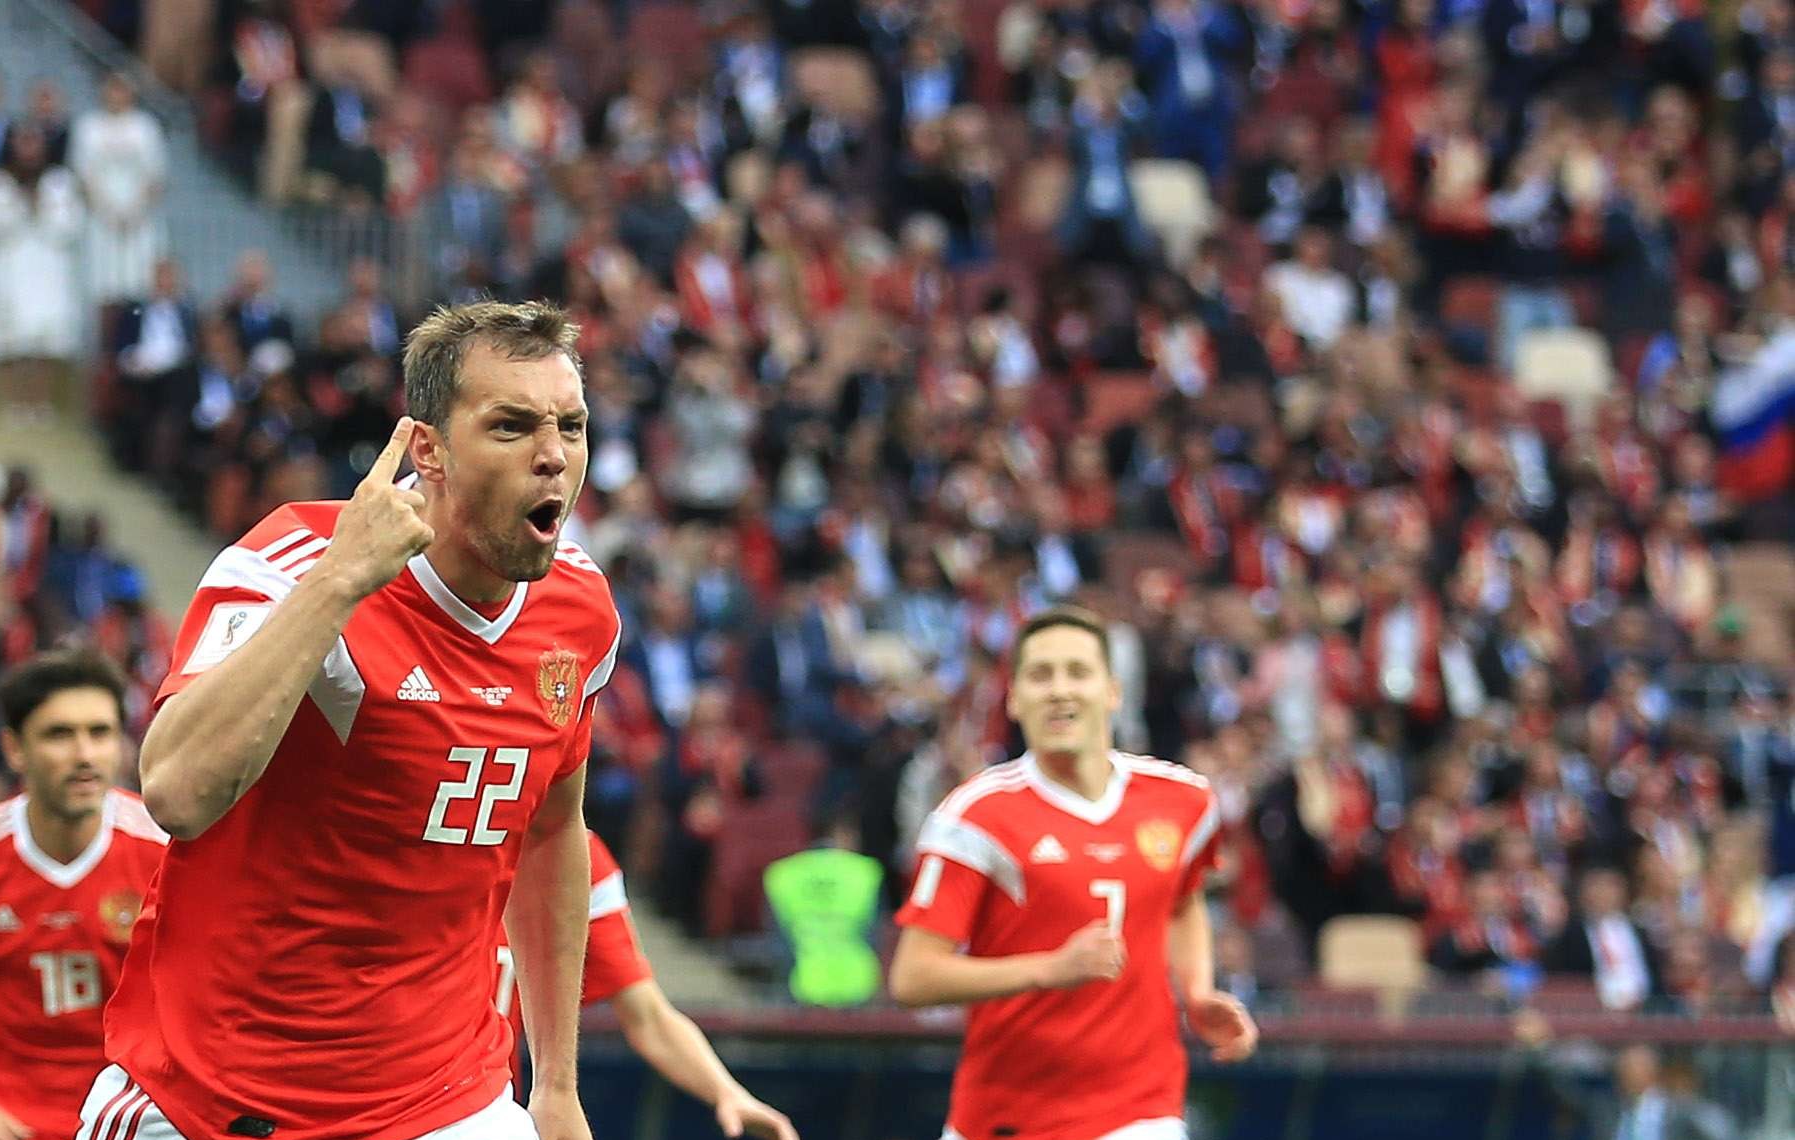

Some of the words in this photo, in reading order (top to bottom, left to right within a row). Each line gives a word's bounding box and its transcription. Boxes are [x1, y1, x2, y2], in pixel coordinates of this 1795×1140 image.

[397, 689, 441, 702] adidas
[423, 747, 530, 844] 22
[29, 951, 102, 1016] 18
